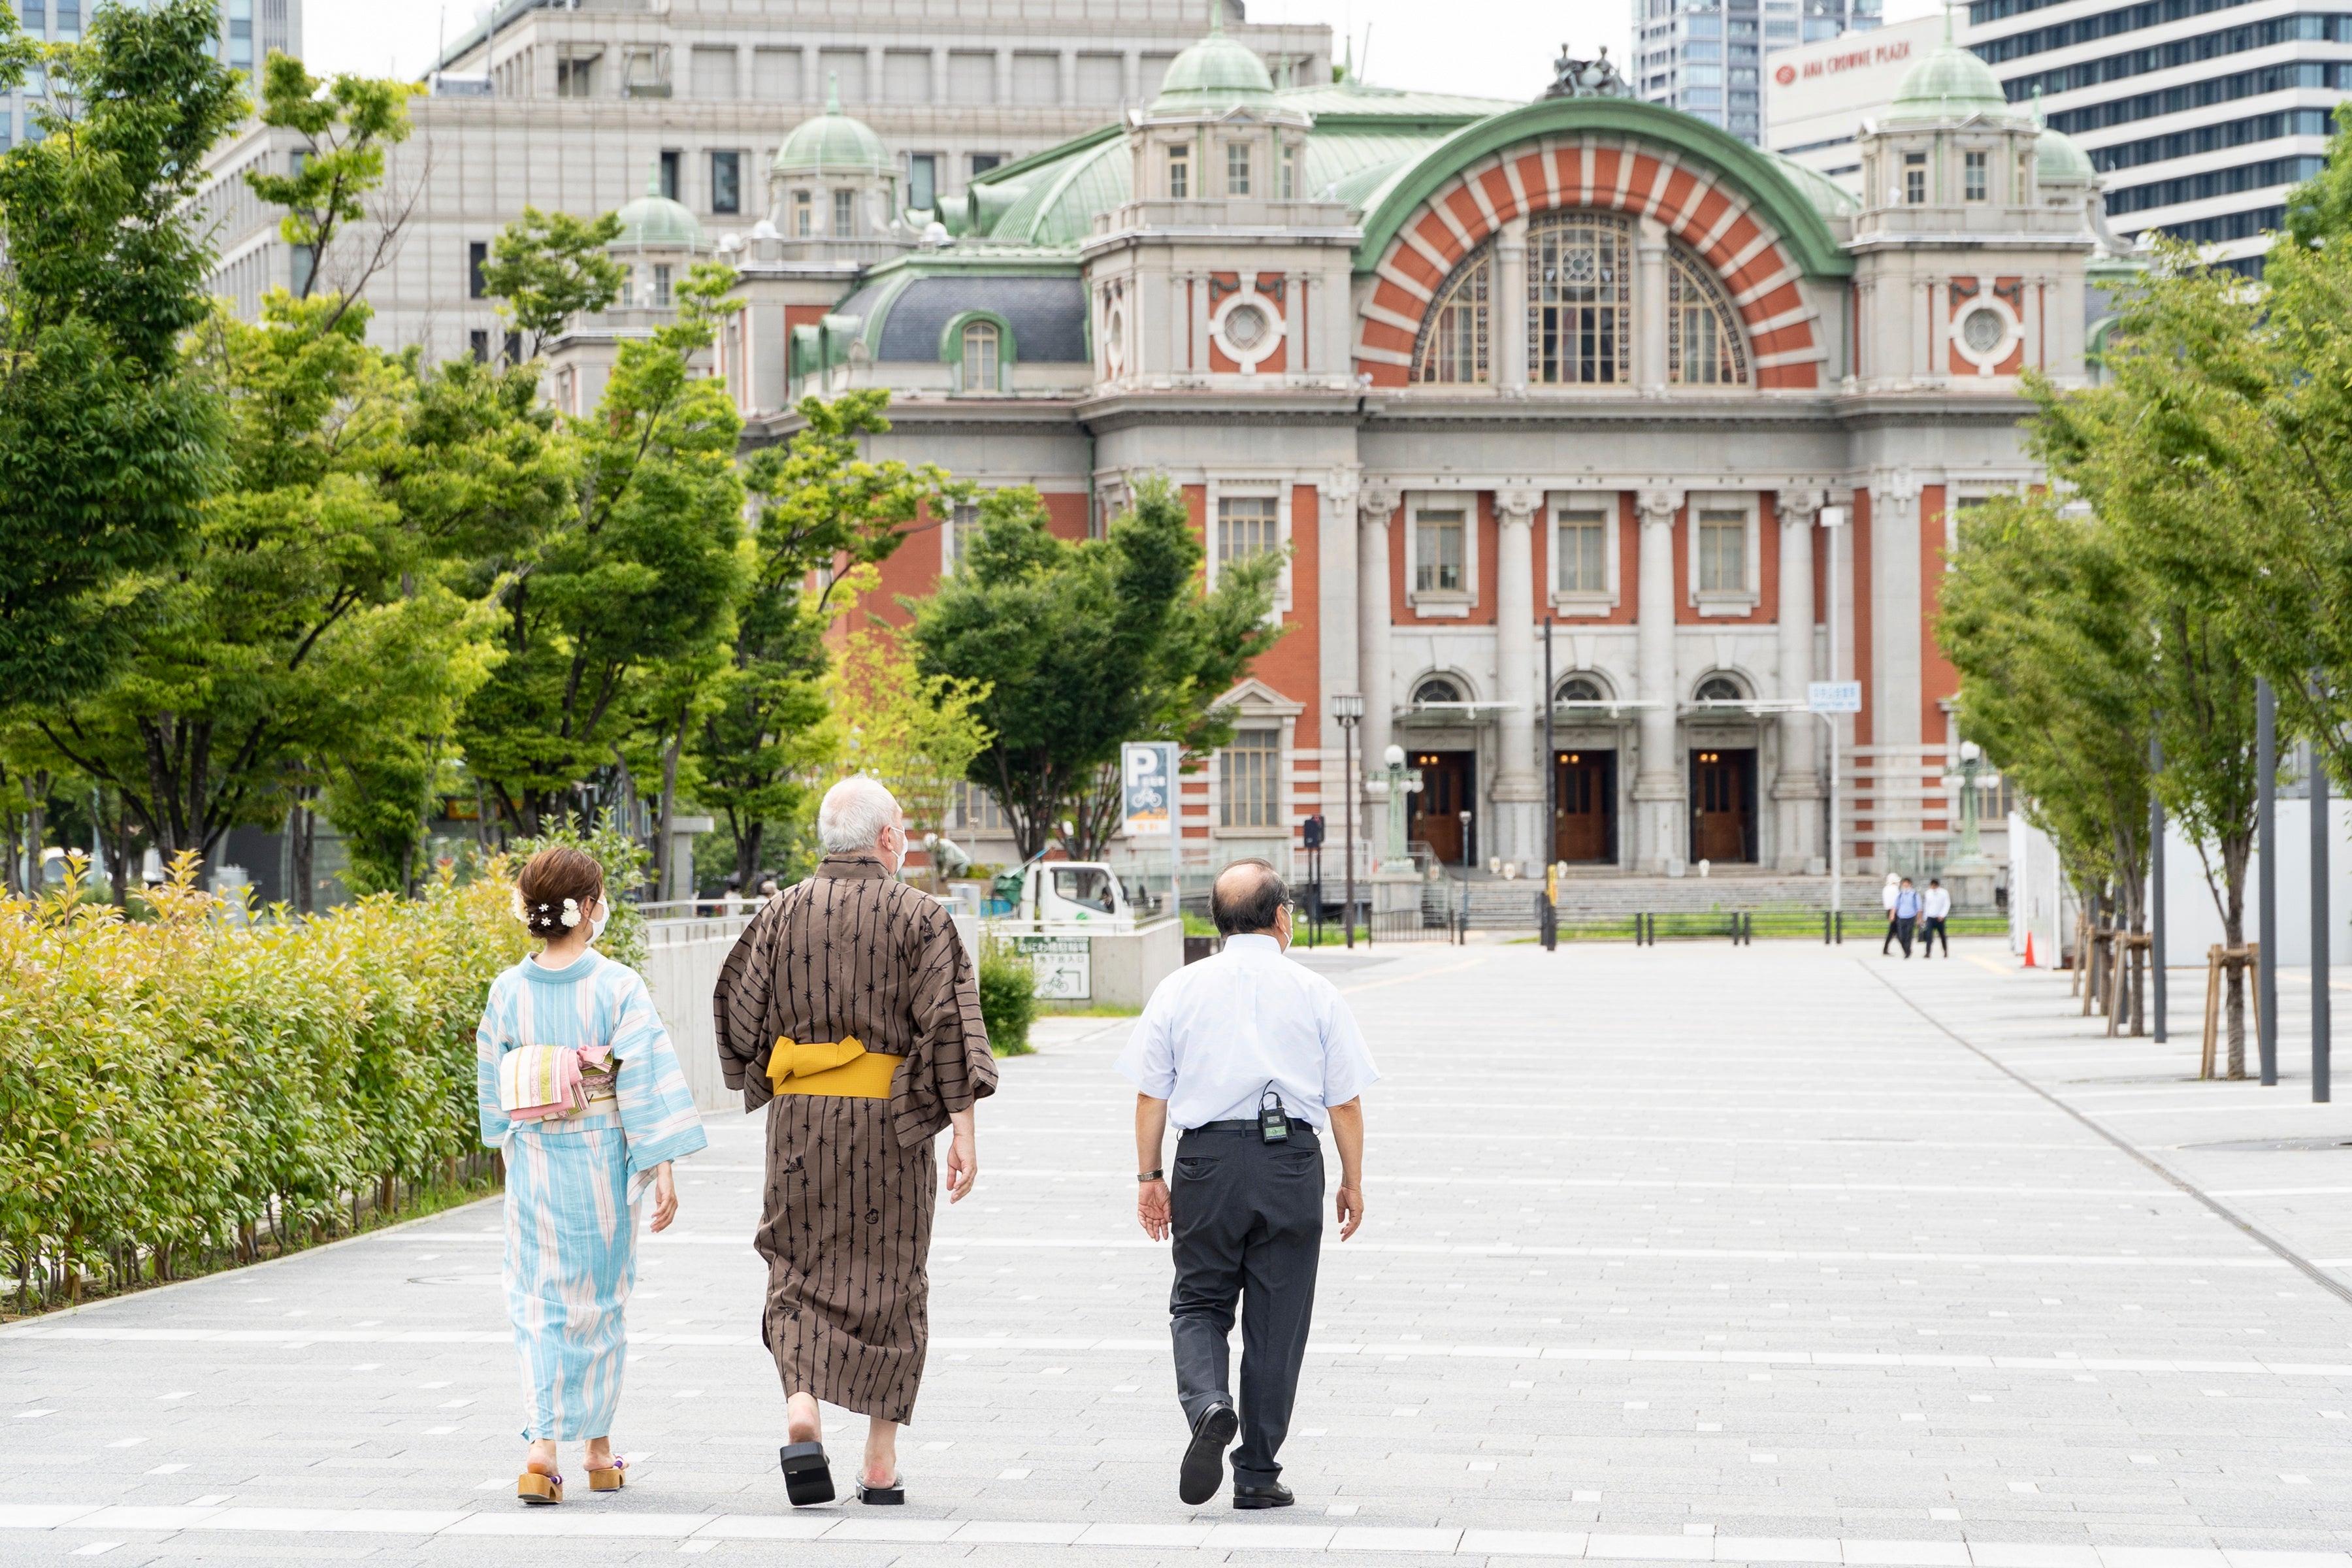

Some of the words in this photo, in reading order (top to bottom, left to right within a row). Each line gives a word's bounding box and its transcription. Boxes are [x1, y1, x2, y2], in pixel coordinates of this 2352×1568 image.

[1803, 61, 1823, 78] ANA
[1876, 41, 1910, 63] PLAZA
[1127, 748, 1158, 787] P
